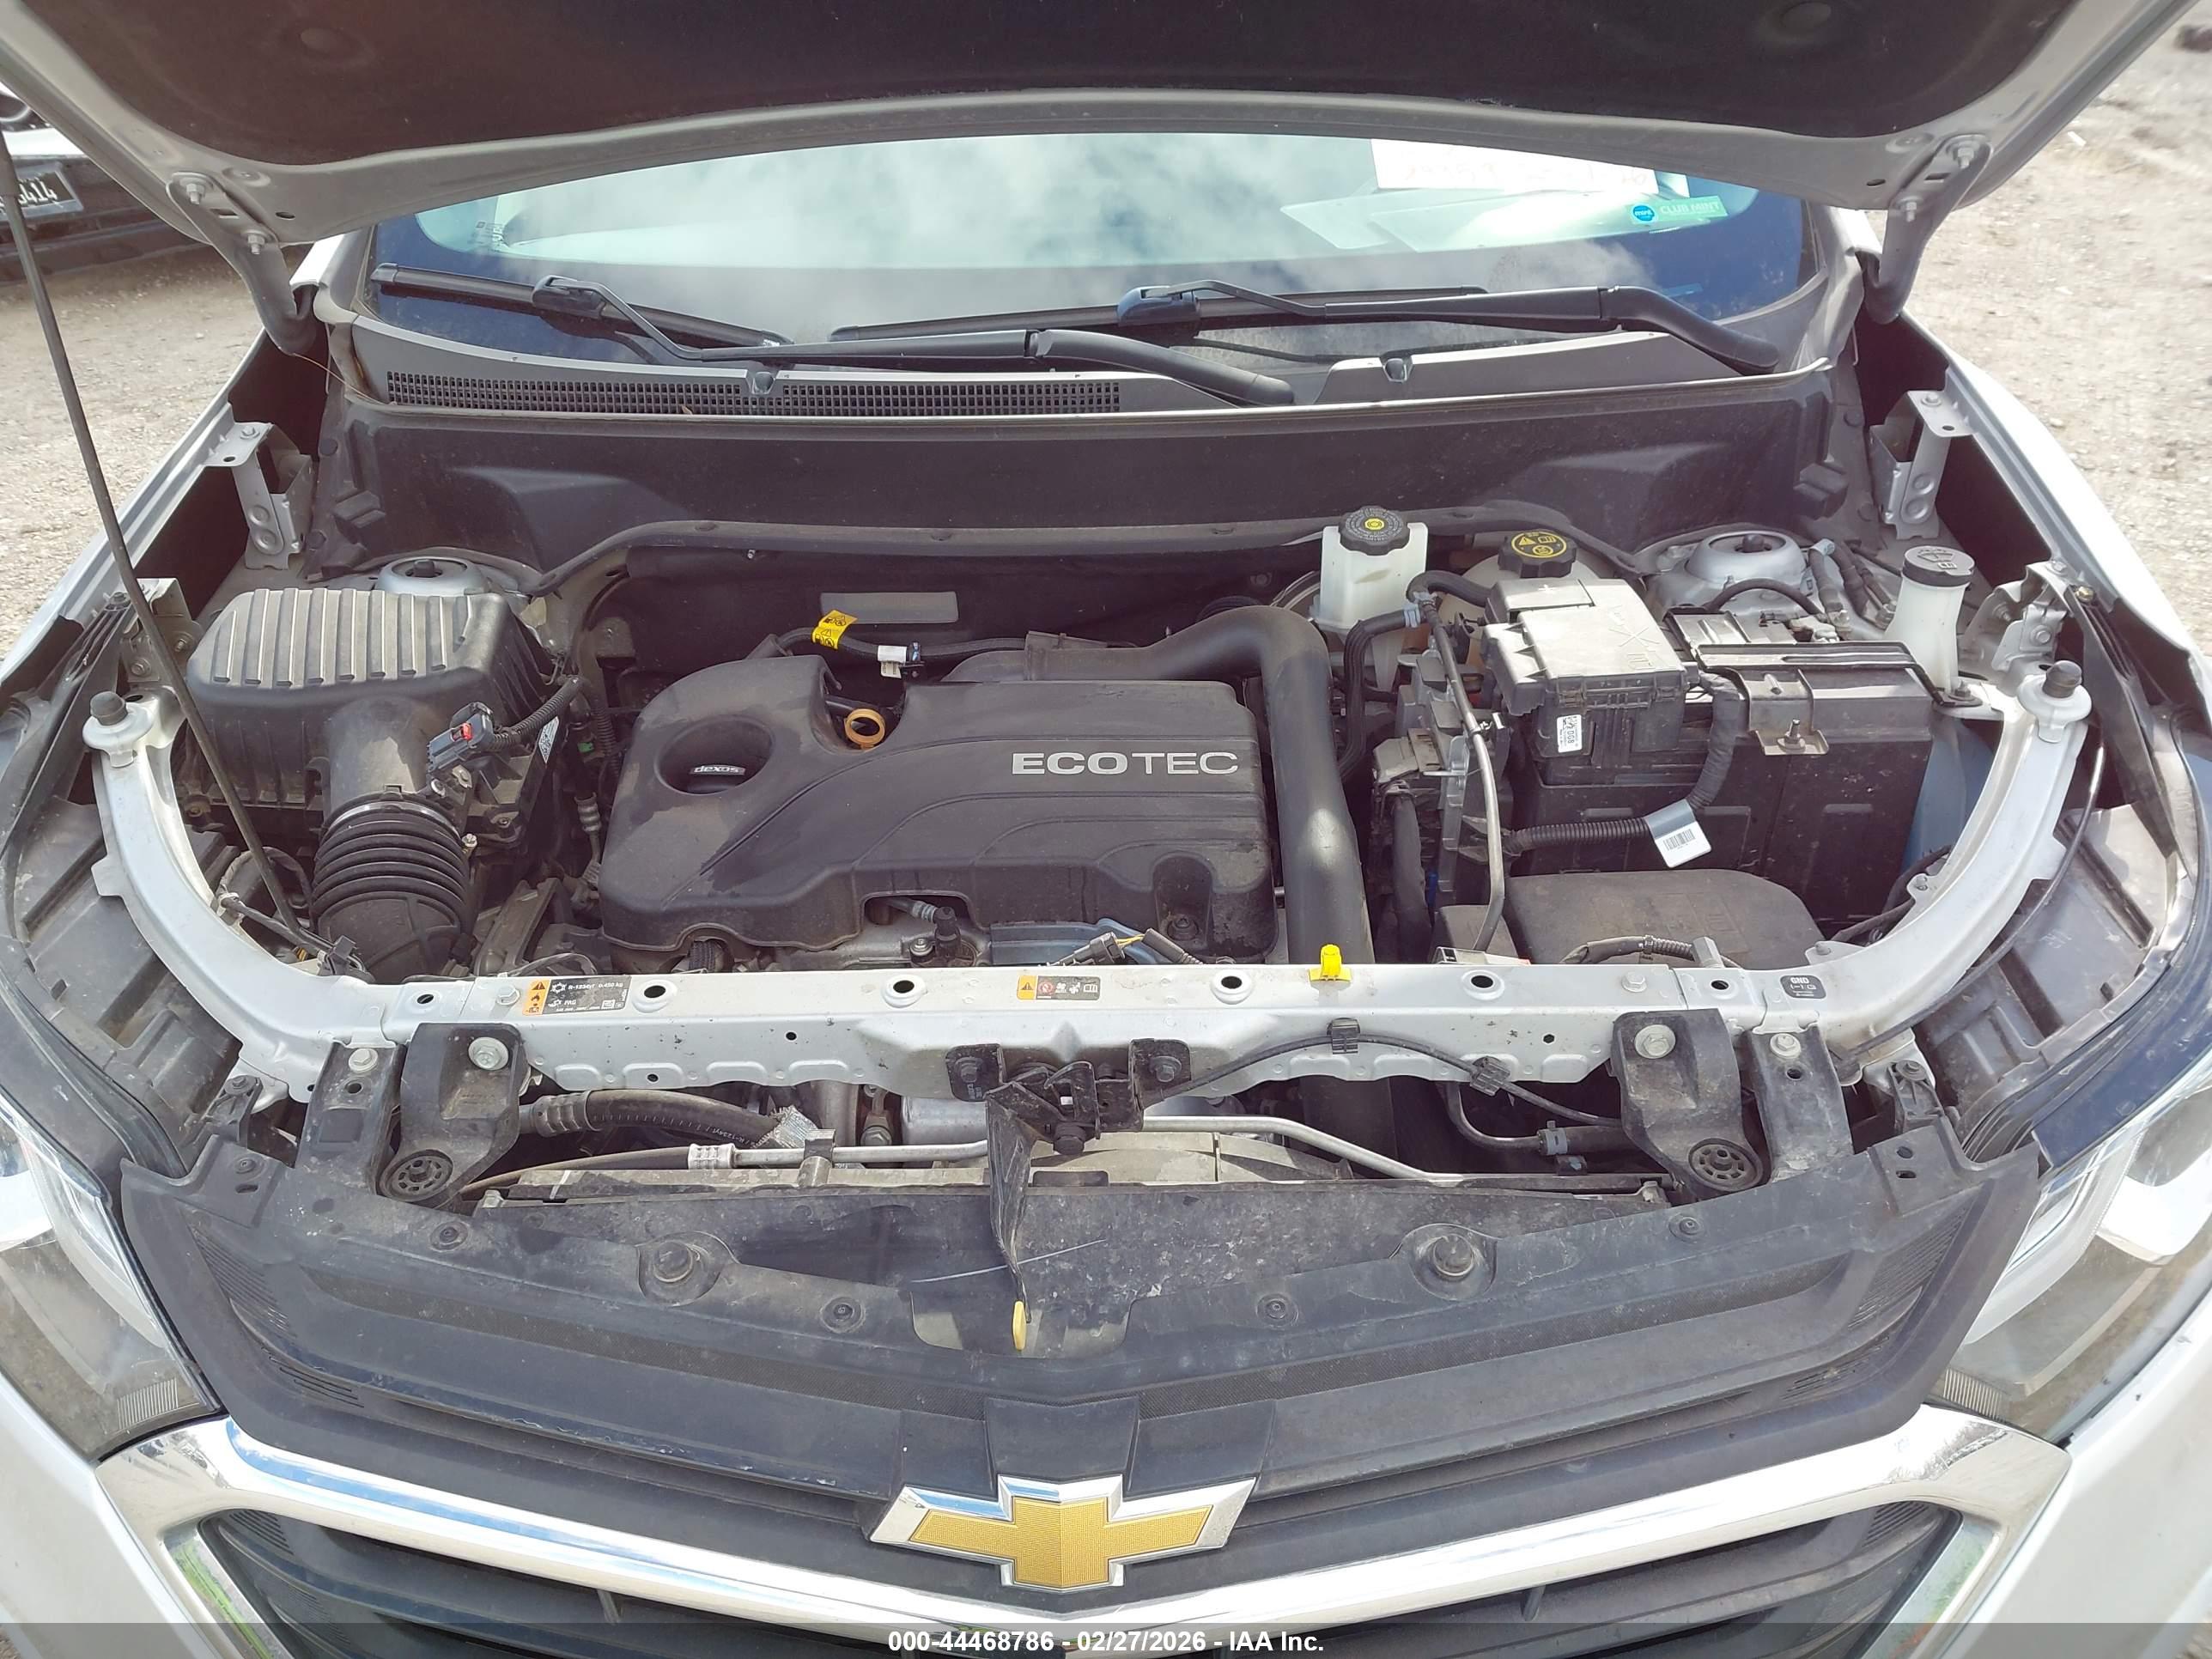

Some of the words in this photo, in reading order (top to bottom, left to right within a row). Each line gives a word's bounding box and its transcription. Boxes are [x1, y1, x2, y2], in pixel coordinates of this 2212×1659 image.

[1660, 204, 1690, 214] CLUB
[1691, 201, 1720, 212] MINT
[1012, 752, 1239, 775] ECOTEC
